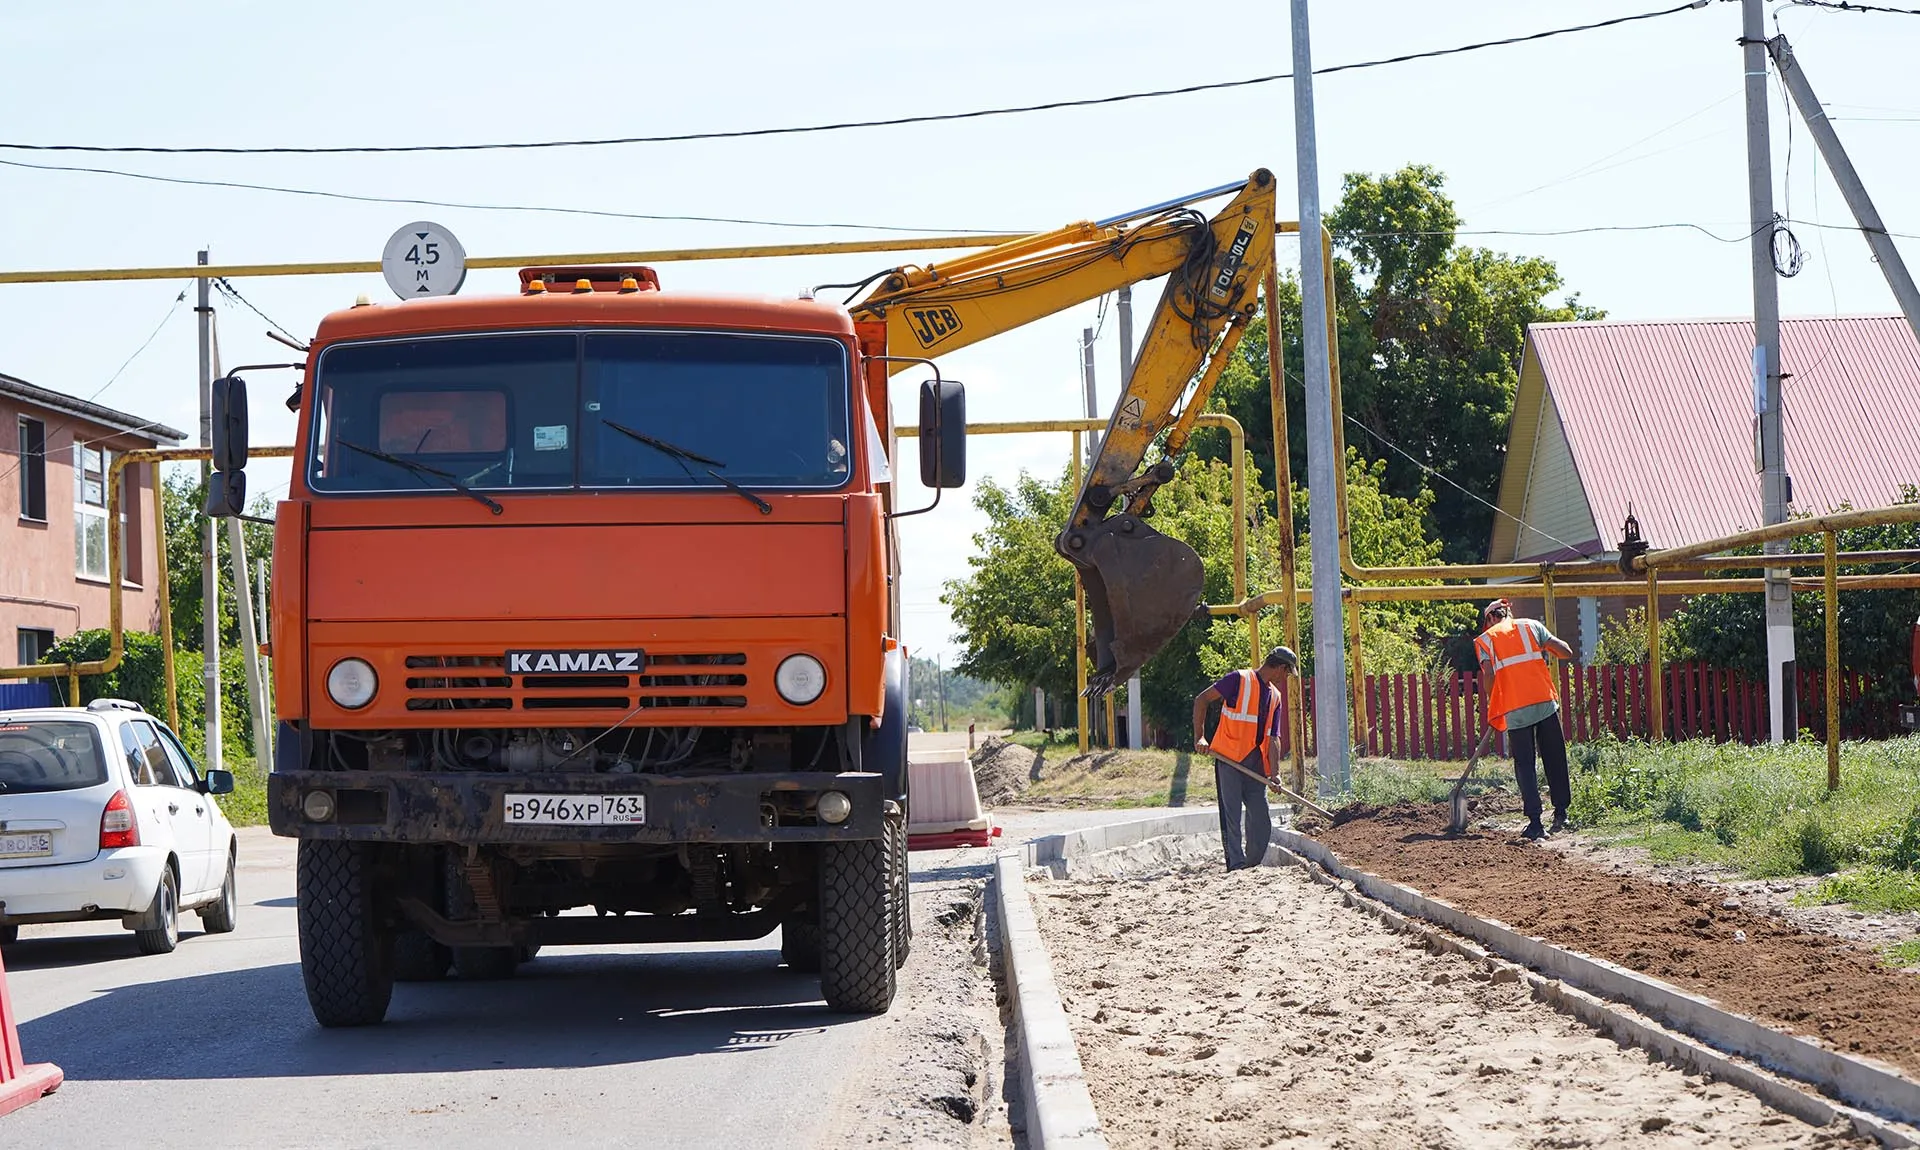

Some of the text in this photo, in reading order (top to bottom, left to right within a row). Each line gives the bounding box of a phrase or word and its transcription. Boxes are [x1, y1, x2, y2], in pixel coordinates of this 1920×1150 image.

[912, 309, 957, 343] JCB
[511, 652, 639, 672] KAMAZ
[604, 797, 638, 815] 763
